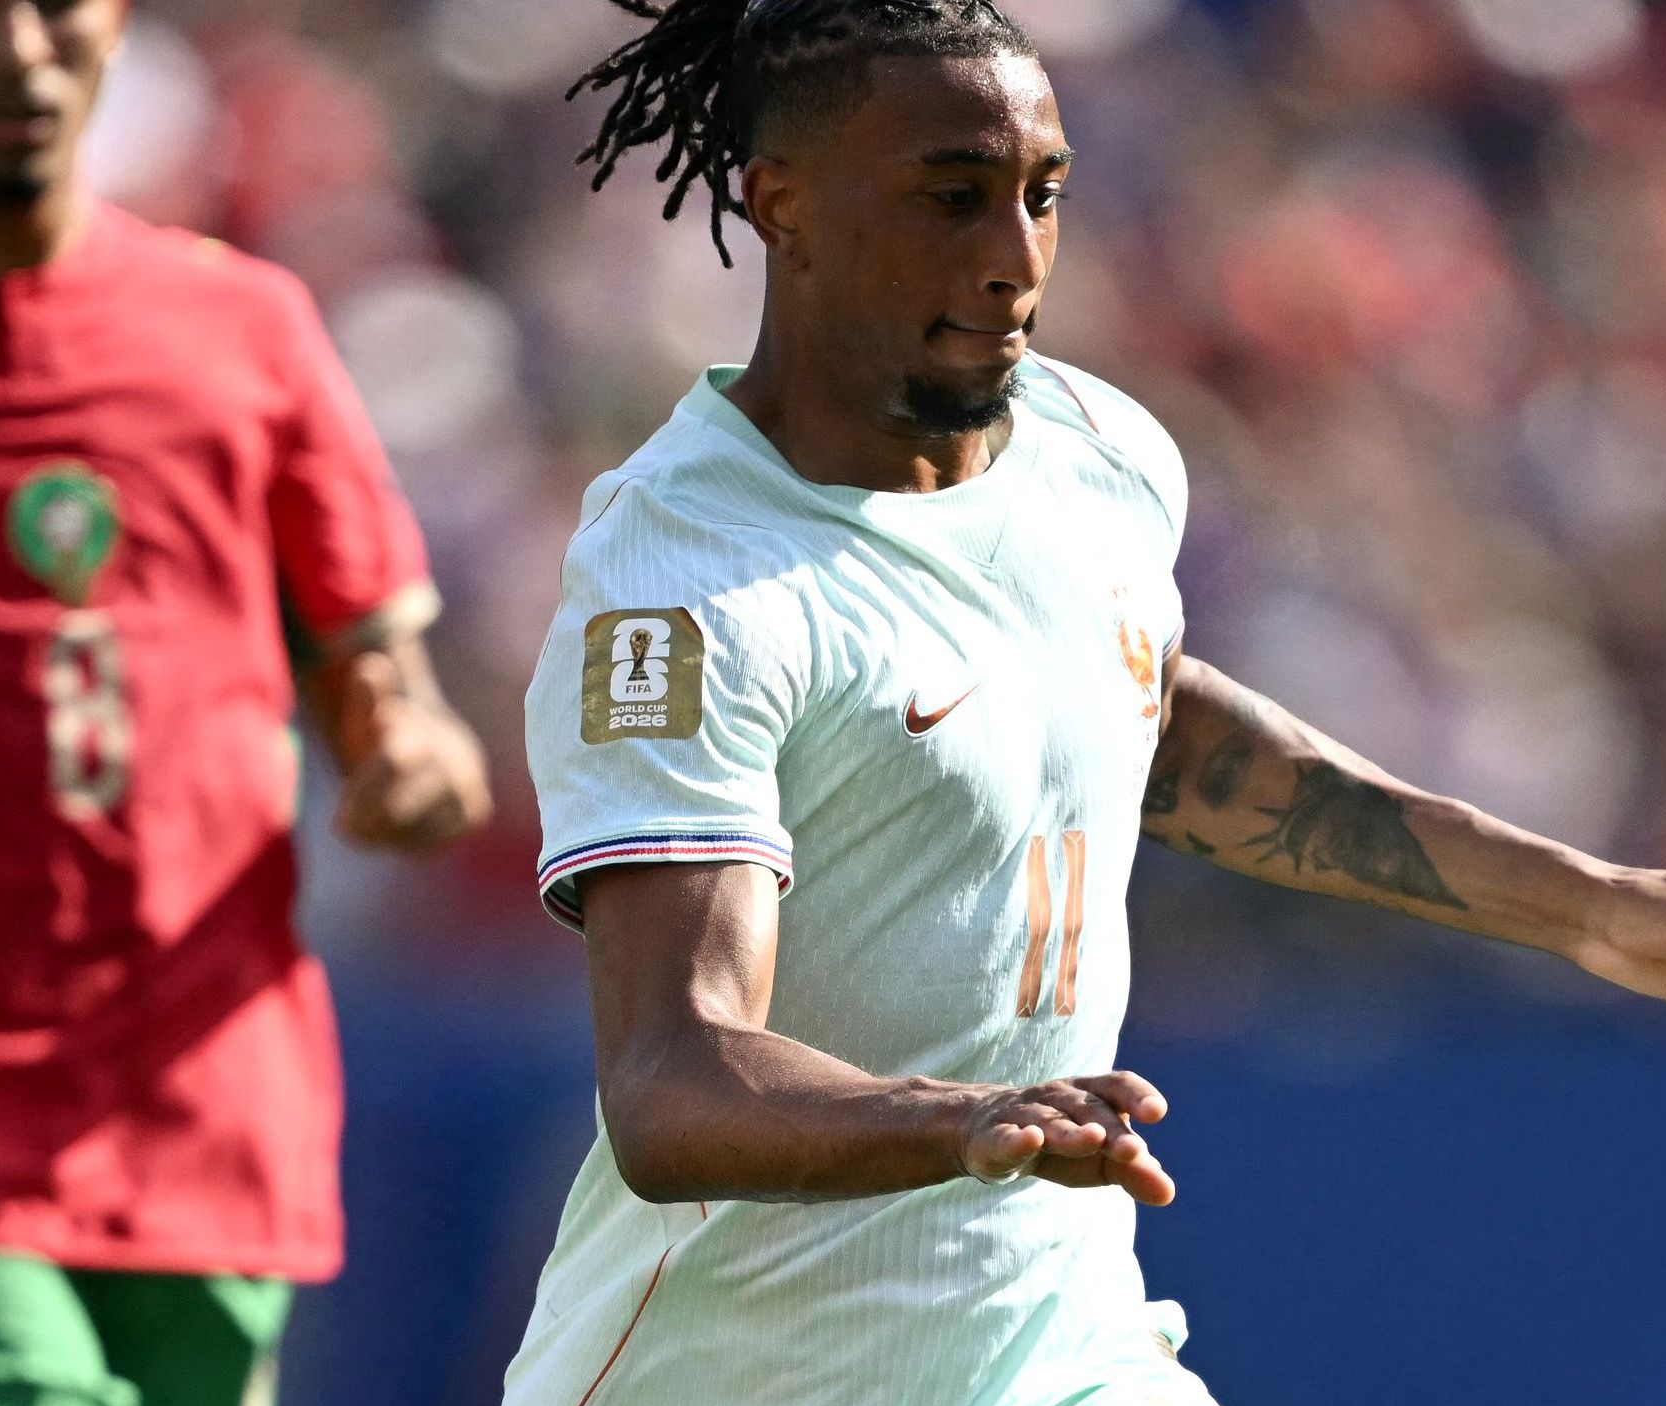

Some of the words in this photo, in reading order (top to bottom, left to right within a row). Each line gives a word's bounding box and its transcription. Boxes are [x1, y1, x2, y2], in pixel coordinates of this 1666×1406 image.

[625, 684, 652, 694] FIFA
[609, 705, 645, 715] WORLD
[647, 705, 668, 713] CUP
[609, 714, 667, 729] 2026
[1016, 830, 1086, 1018] 11
